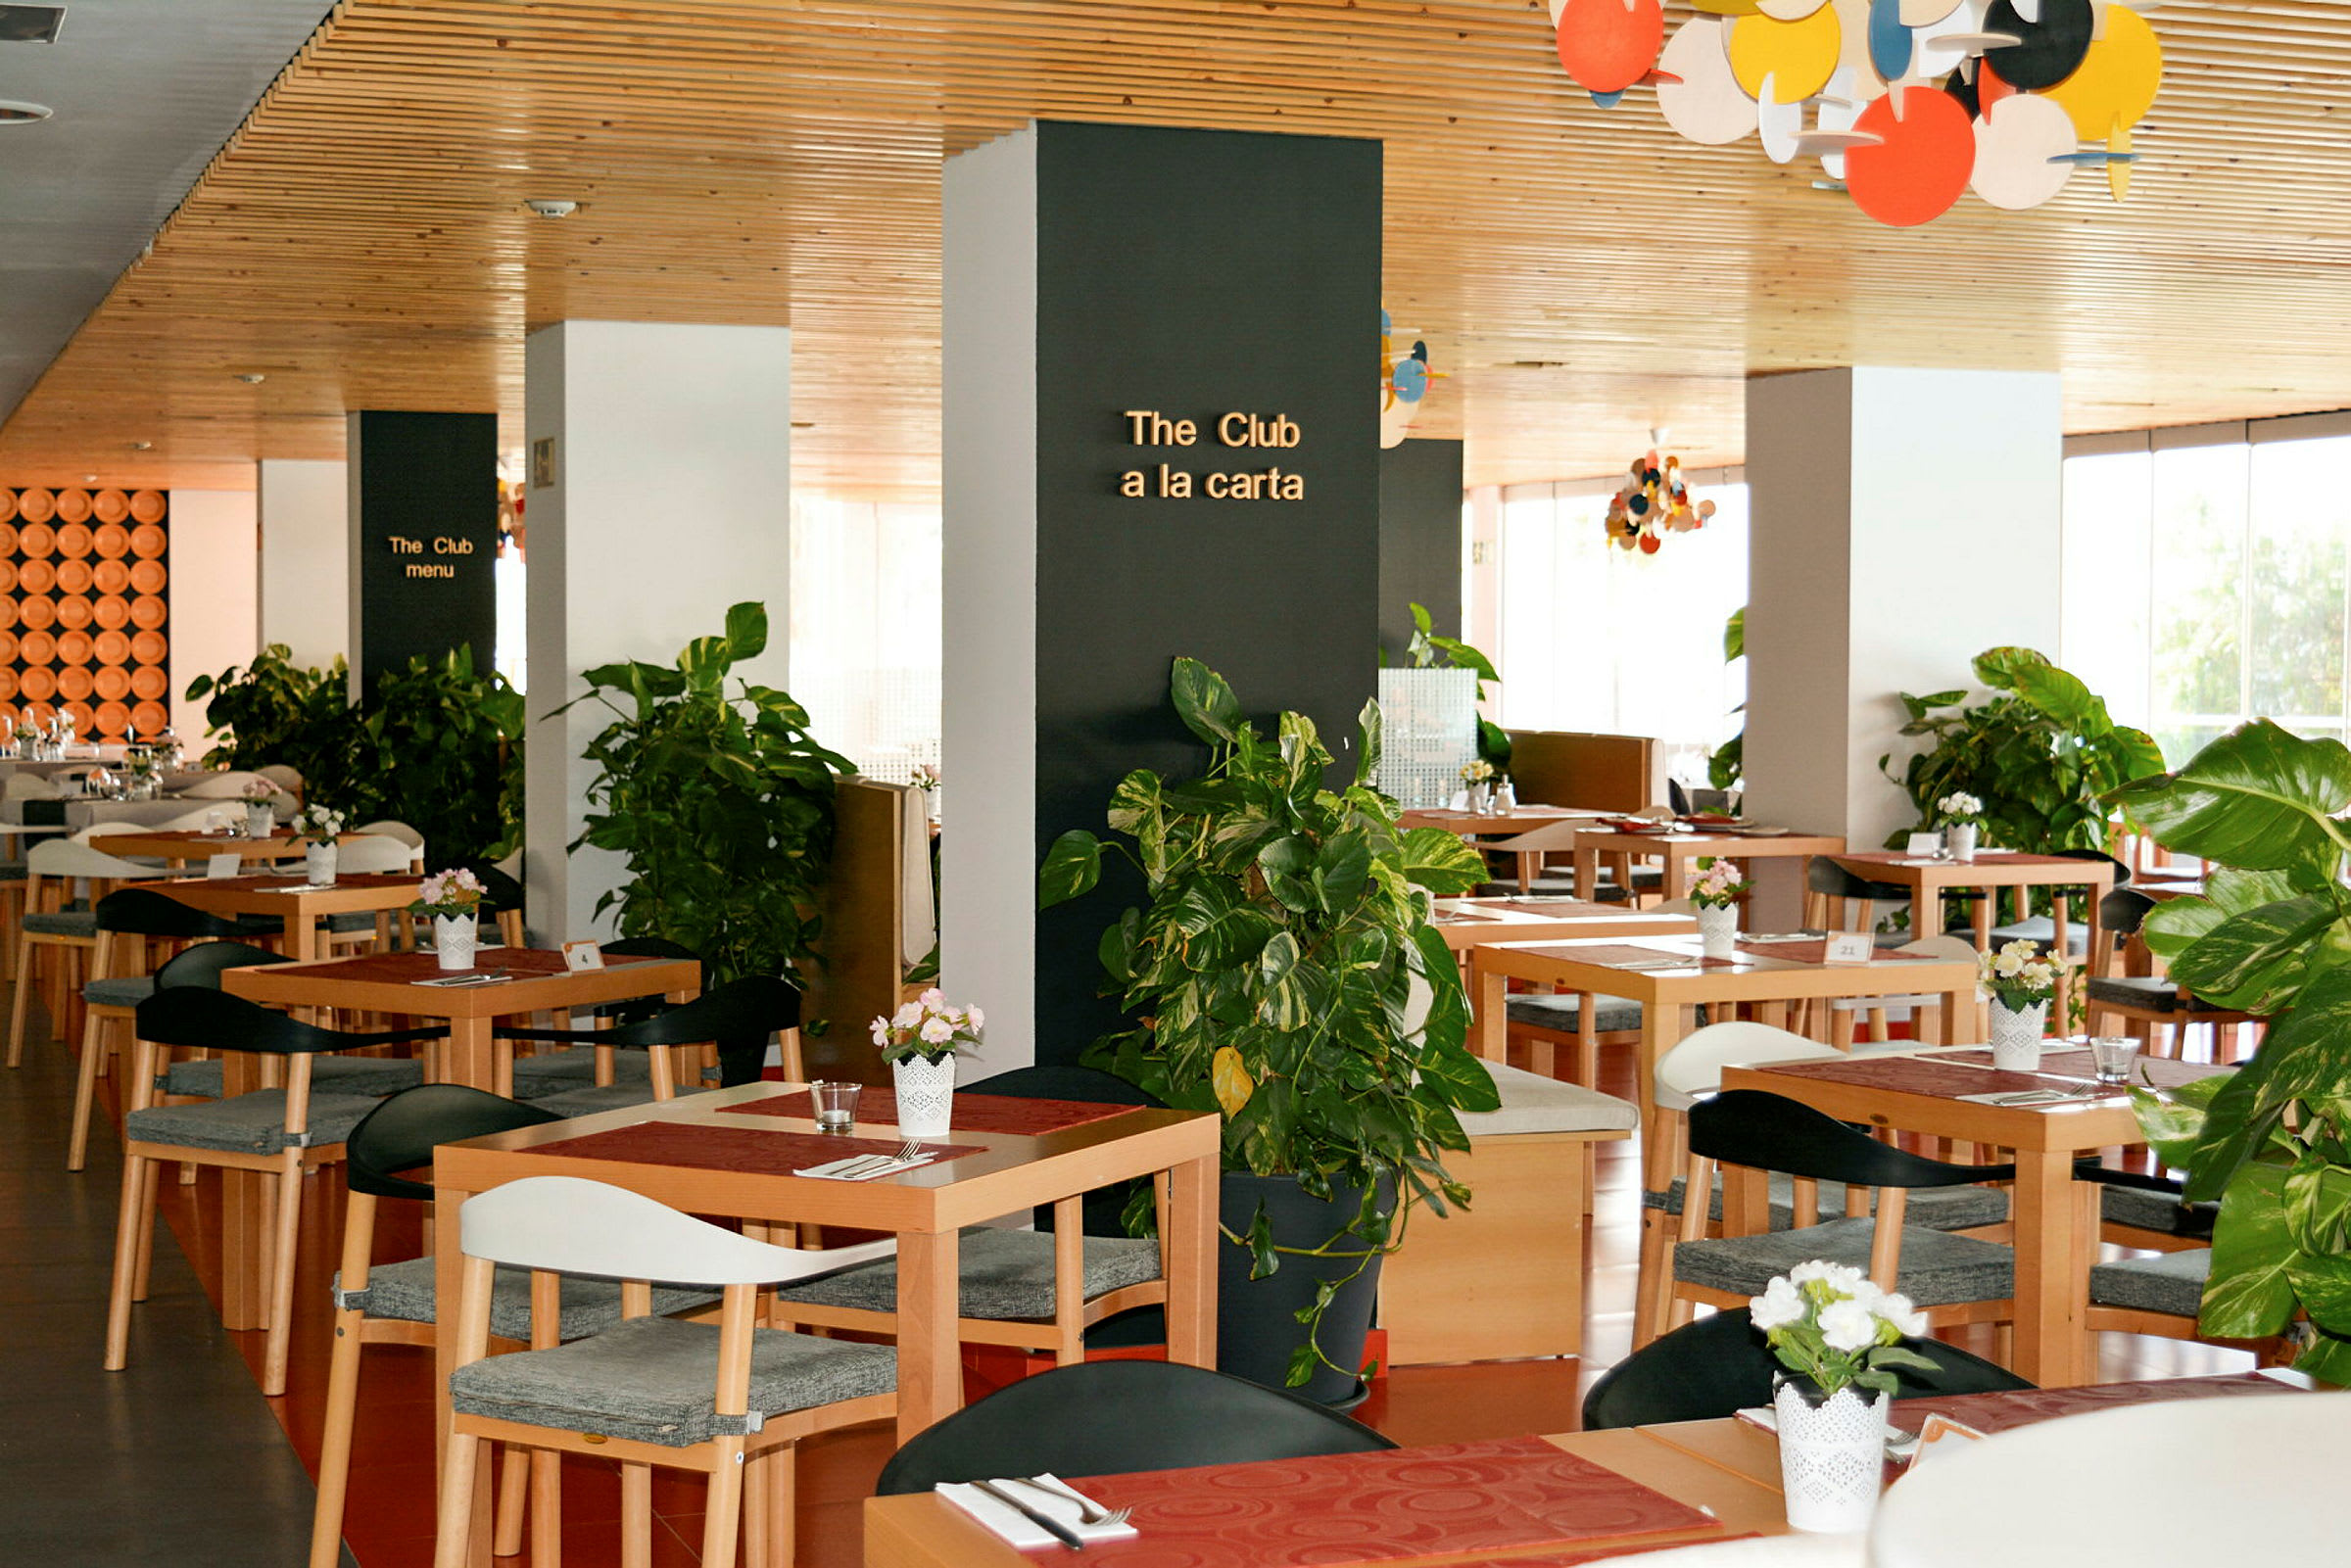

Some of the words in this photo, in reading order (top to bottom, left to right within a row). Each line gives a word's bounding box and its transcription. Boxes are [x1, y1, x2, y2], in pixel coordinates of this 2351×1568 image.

[1125, 410, 1197, 446] The
[1218, 411, 1301, 448] Club
[1120, 470, 1145, 498] a
[1159, 463, 1192, 498] la
[1205, 466, 1304, 500] carta
[388, 536, 423, 554] The
[433, 536, 473, 554] Club
[406, 564, 455, 578] menu
[1840, 945, 1855, 956] 21
